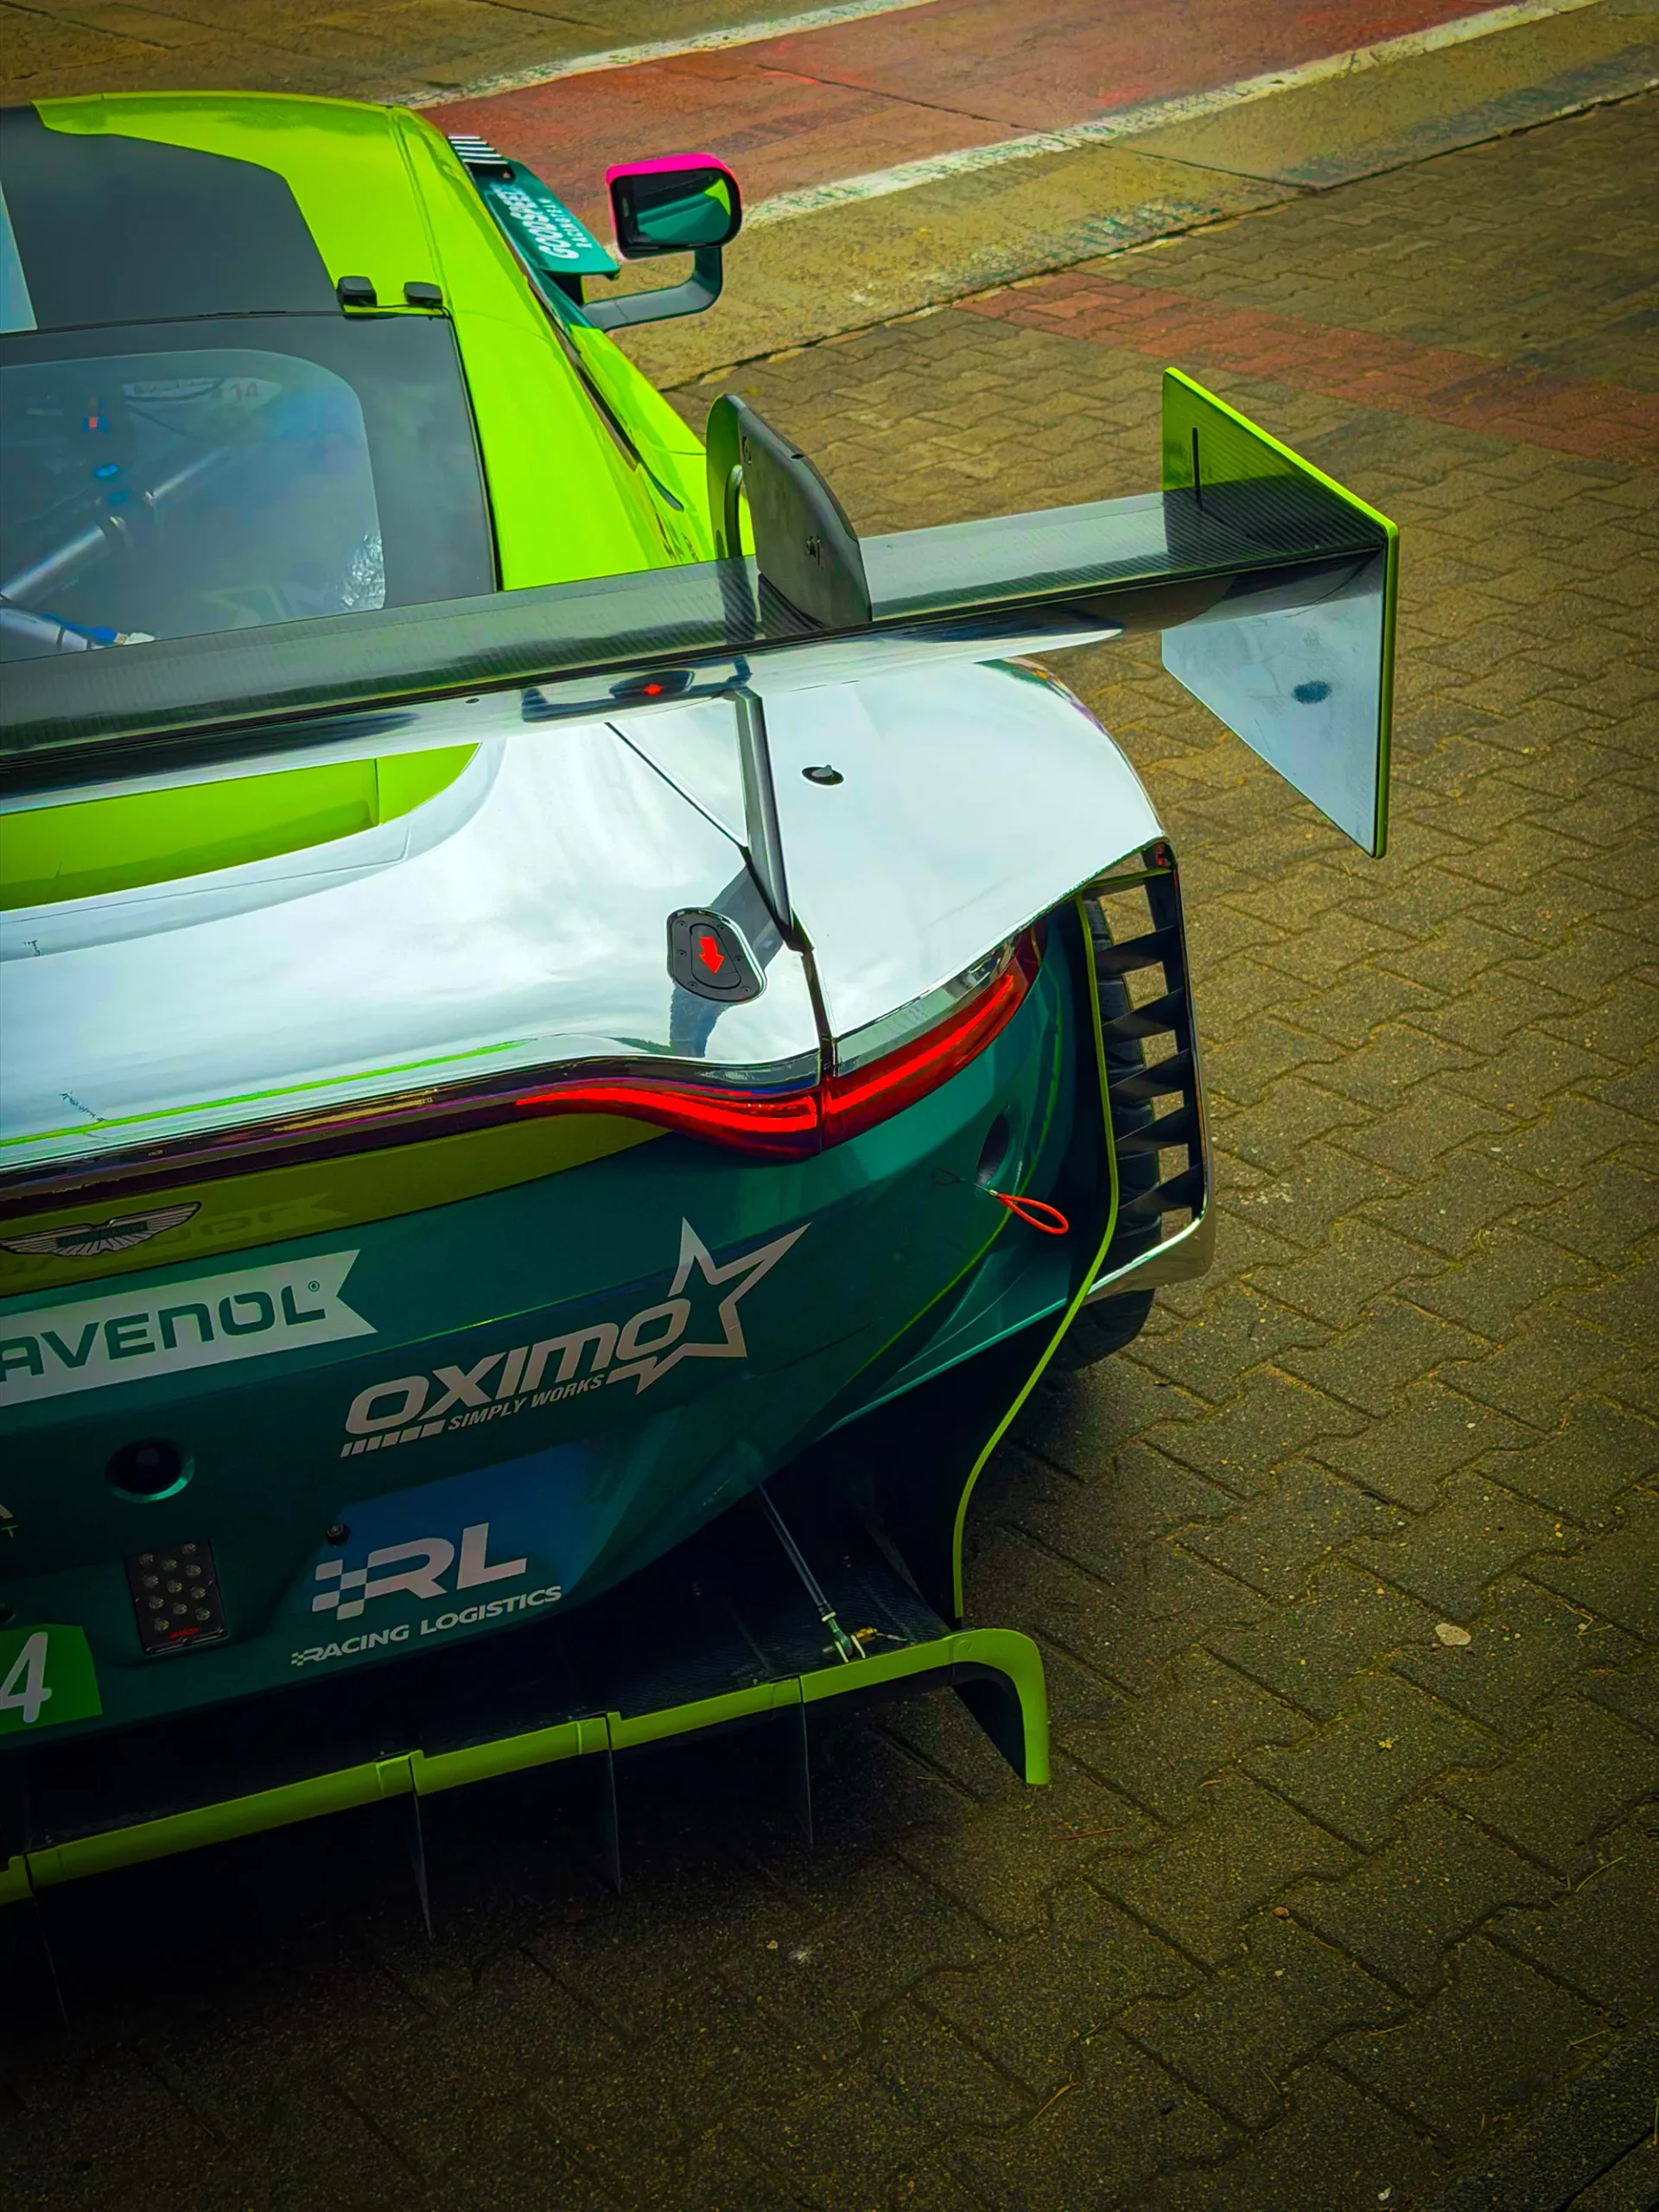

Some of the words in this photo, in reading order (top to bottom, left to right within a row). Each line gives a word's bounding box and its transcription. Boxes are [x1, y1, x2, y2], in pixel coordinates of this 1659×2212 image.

[345, 1299, 690, 1435] OXIMO
[448, 1397, 528, 1431] SIMPLY
[531, 1374, 605, 1408] WORKS
[364, 1522, 527, 1599] RL
[292, 1624, 410, 1666] RACING
[420, 1586, 562, 1636] LOGISTICS
[0, 1631, 52, 1723] 4
